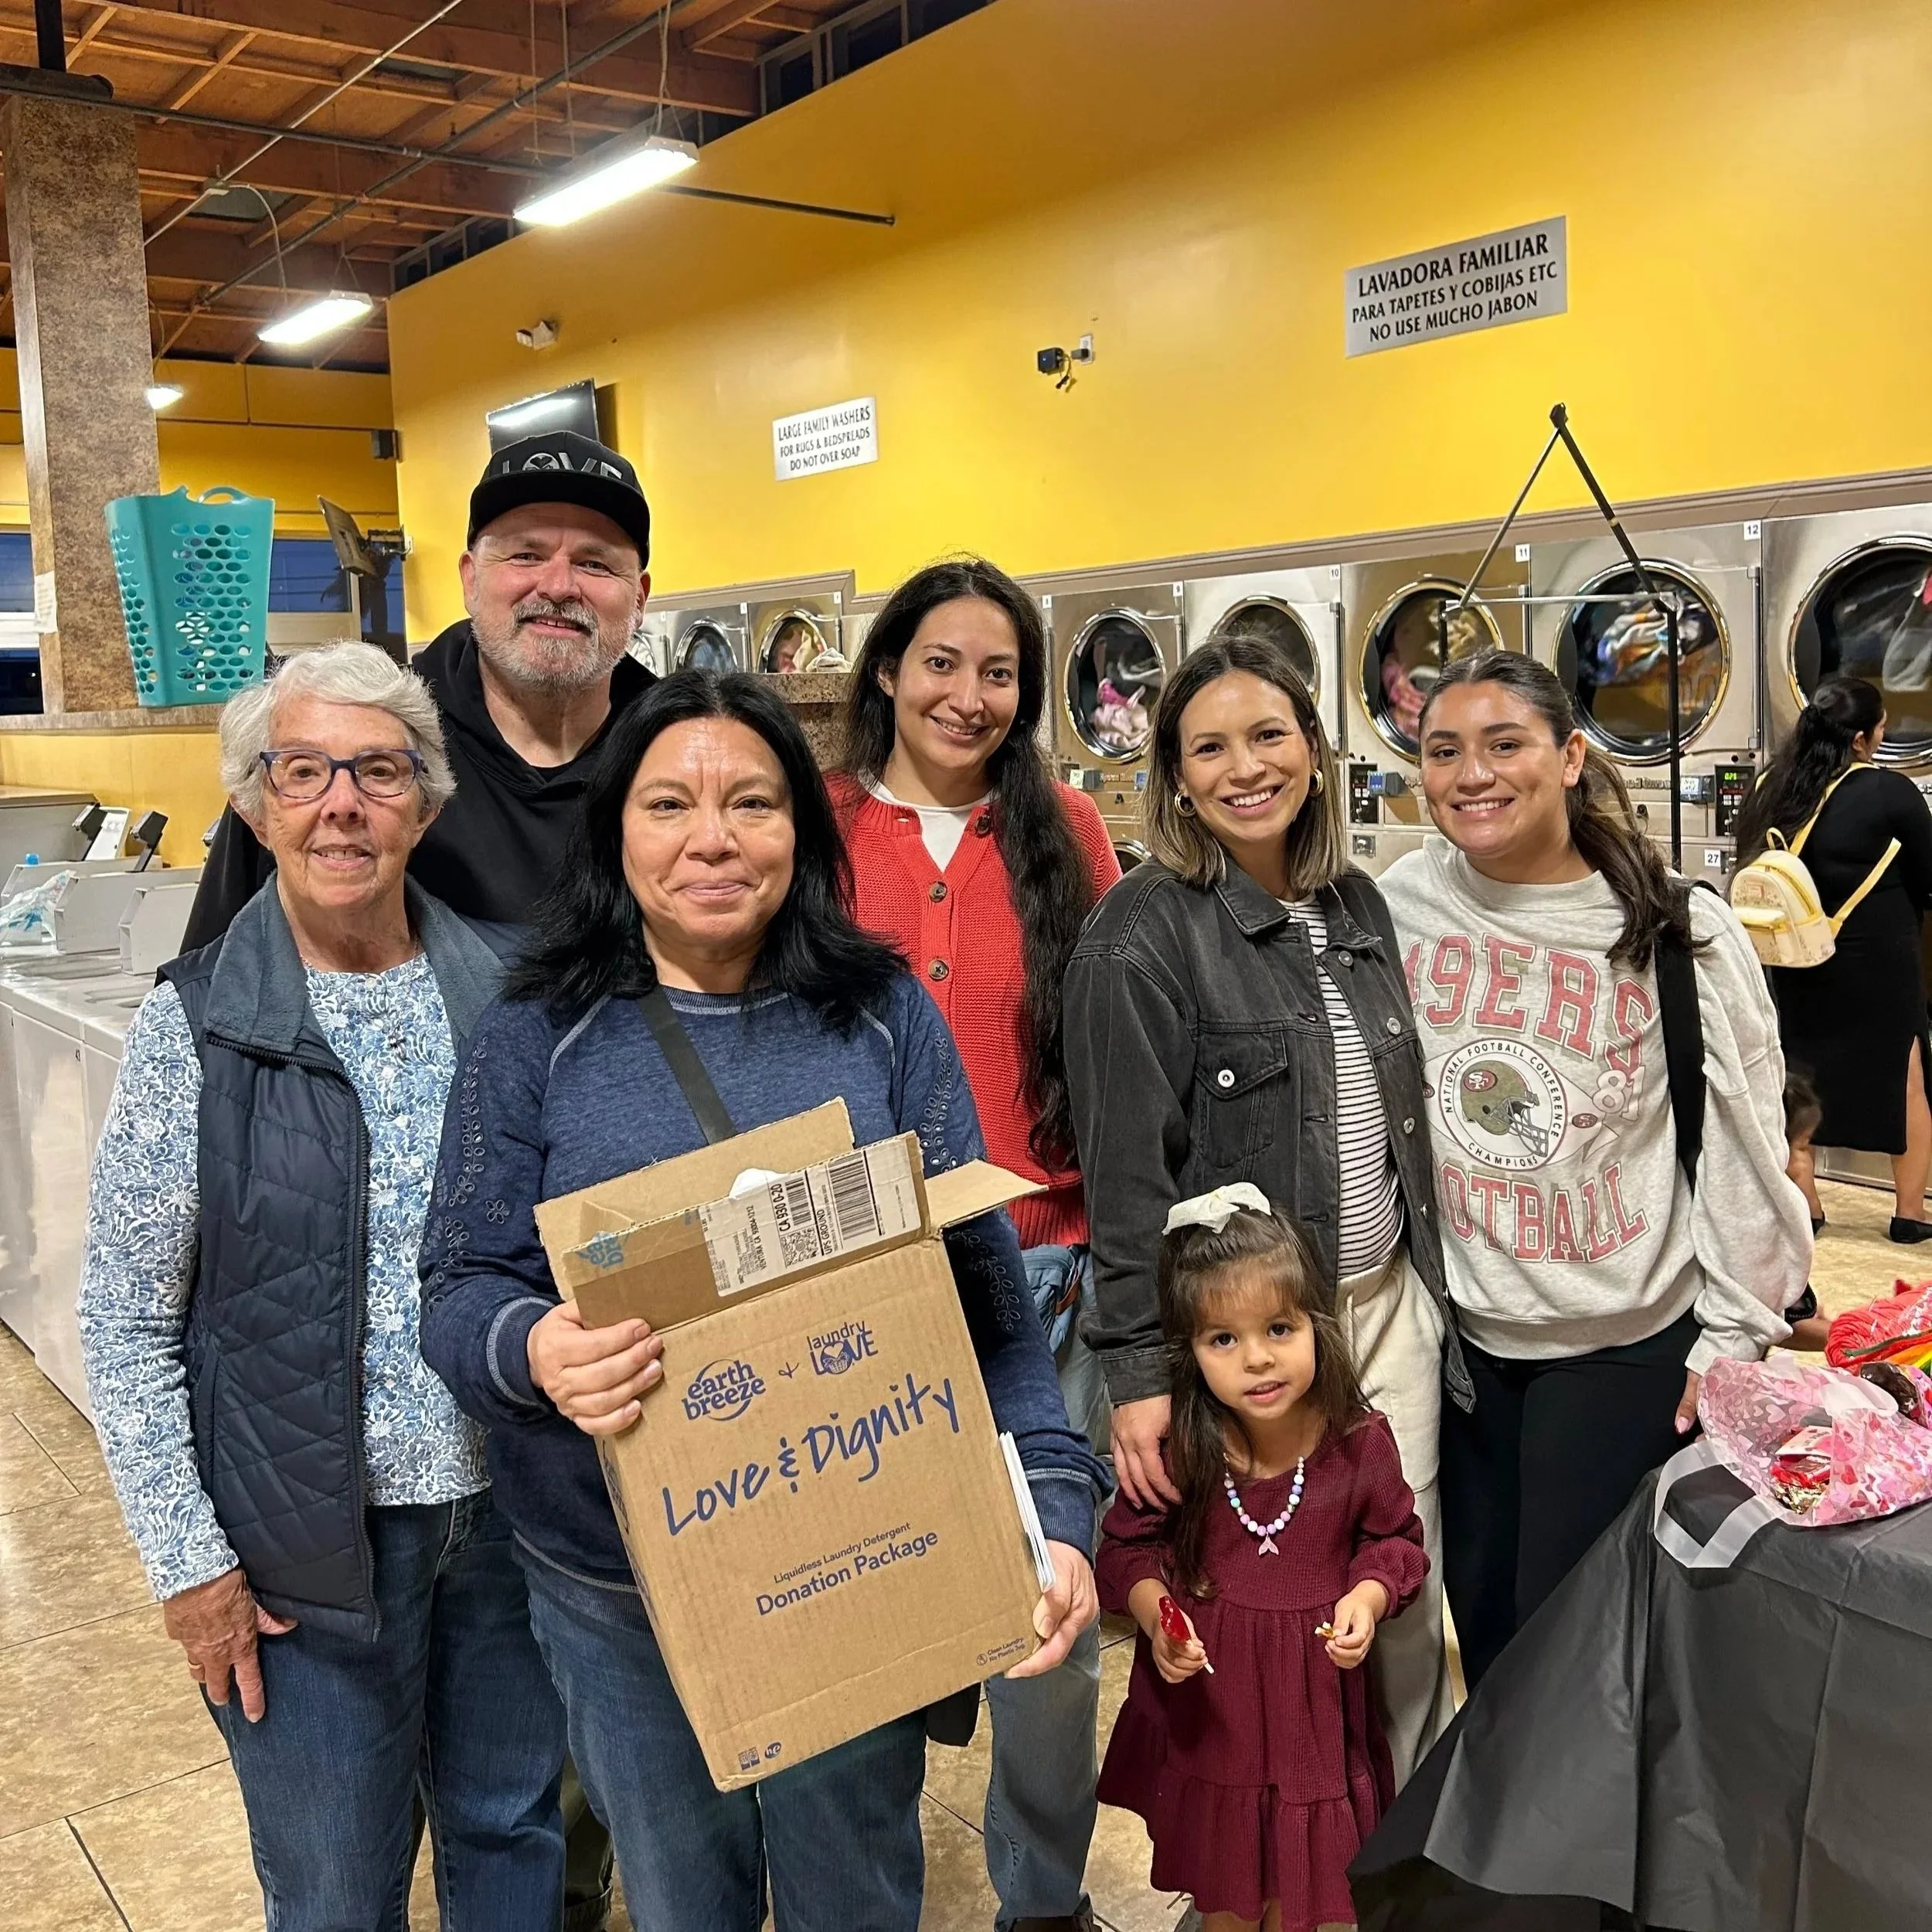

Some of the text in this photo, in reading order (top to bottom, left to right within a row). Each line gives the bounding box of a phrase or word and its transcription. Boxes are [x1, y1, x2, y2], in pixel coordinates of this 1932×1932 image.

[1359, 233, 1549, 298] LAVADORA FAMILIAR
[1352, 261, 1557, 323] PARA TAPETES Y COBIJAS ETC
[1369, 290, 1538, 342] NO USE MUCHO JABON
[778, 405, 871, 441] LARGE FAMILY WASHERS
[780, 426, 870, 458] FOR RUGS & BEDSPREADS
[790, 445, 861, 471] DO NOT OVER SOAP
[1747, 524, 1758, 536] 12
[1519, 547, 1528, 558] 11
[1332, 568, 1339, 577] 10
[1707, 853, 1719, 864] 27
[1445, 1042, 1563, 1138] NATIONAL FOOTBALL CONFERENCE
[1593, 1065, 1645, 1122] 81
[1468, 1141, 1538, 1165] CHAMPIONS
[770, 1183, 791, 1232] CA 930 0-20
[817, 1209, 830, 1240] GROUND
[755, 1245, 767, 1270] VENTURA
[823, 1240, 833, 1255] UPS
[806, 1320, 866, 1351] laundry
[810, 1329, 879, 1376] LOVE
[688, 1359, 755, 1399] earth
[681, 1378, 766, 1420] breeze
[662, 1462, 770, 1536] Love
[777, 1437, 800, 1493] &
[801, 1372, 960, 1482] Dignity
[774, 1522, 912, 1584] Liquidless Laundry Detergent
[756, 1529, 938, 1616] Donation Package
